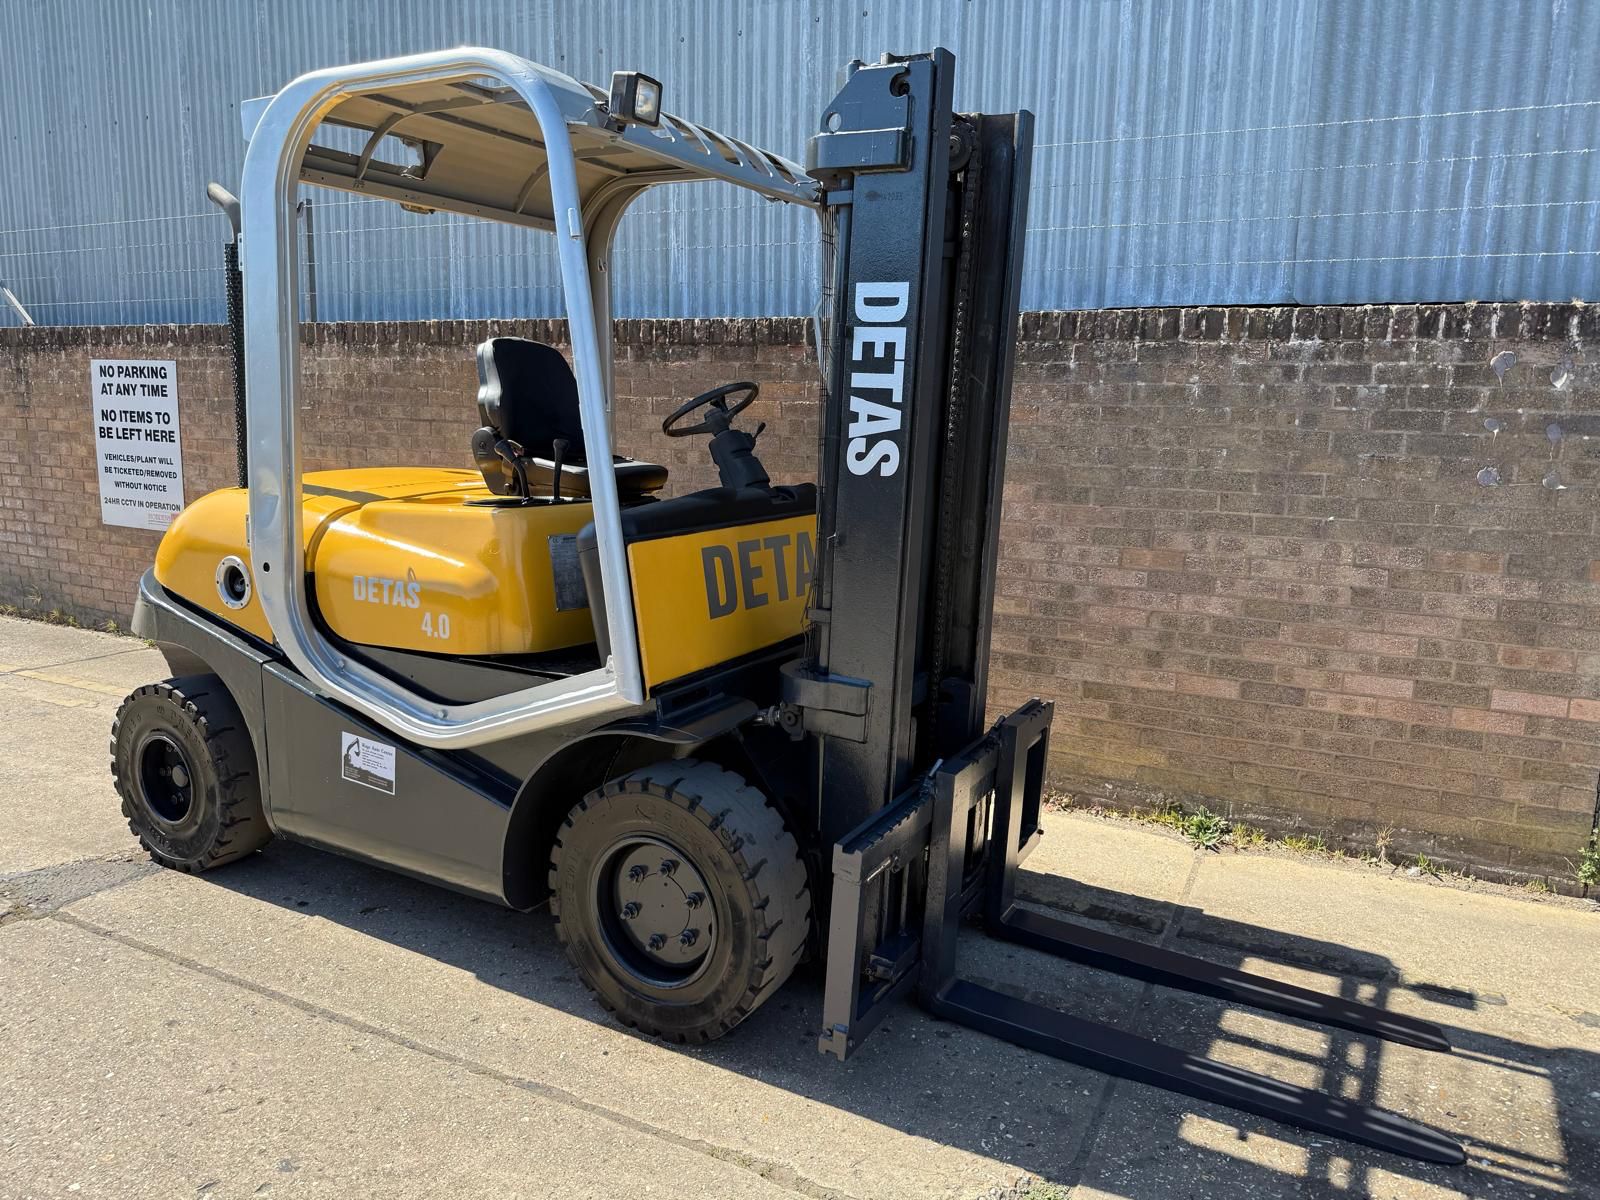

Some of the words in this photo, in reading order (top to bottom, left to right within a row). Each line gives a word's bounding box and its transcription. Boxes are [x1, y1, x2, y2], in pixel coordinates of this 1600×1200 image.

[99, 365, 115, 378] NO
[117, 365, 168, 380] PARKING
[847, 281, 910, 477] DETAS
[101, 382, 114, 395] AT
[116, 383, 137, 396] ANY
[140, 384, 168, 397] TIME
[101, 409, 117, 422] NO
[119, 410, 153, 424] ITEMS
[155, 411, 171, 425] TO
[99, 426, 114, 439] BE
[116, 427, 142, 440] LEFT
[144, 429, 176, 443] HERE
[104, 453, 157, 464] VEHICLES/PLANT
[158, 457, 174, 465] WILL
[104, 466, 113, 474] BE
[113, 467, 177, 479] TICKETED/REMOVED
[114, 481, 142, 490] WITHOUT
[143, 484, 167, 492] NOTICE
[104, 497, 120, 505] 24HR
[121, 499, 137, 507] CCTV
[137, 500, 144, 508] IN
[145, 501, 181, 511] OPERATION
[353, 575, 421, 609] DETAS
[421, 611, 450, 639] 4.0
